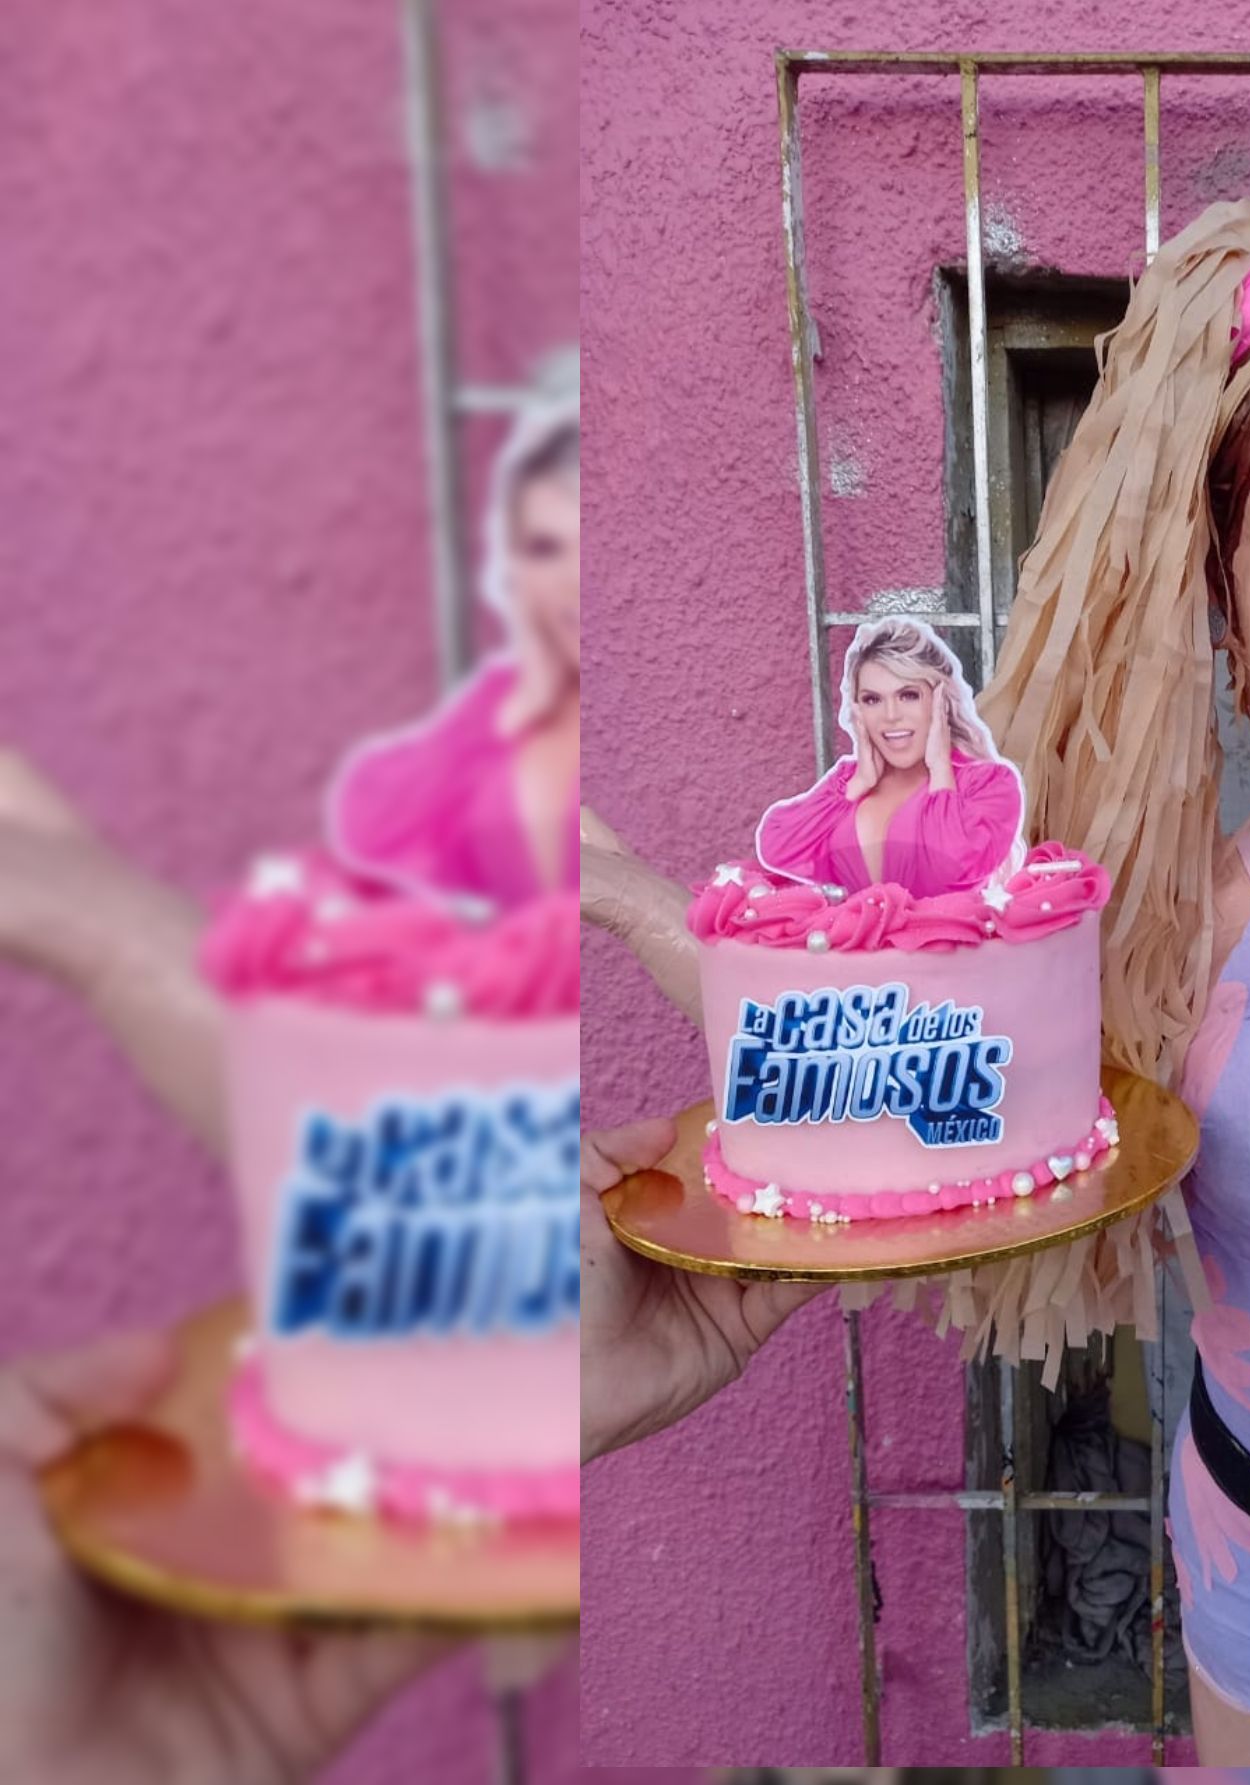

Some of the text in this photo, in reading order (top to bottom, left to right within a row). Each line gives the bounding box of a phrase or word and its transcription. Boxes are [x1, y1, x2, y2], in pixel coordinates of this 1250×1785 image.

[740, 983, 980, 1050] La casa de los
[726, 1038, 1011, 1121] Famosos
[927, 1114, 1000, 1144] MÉXICO
